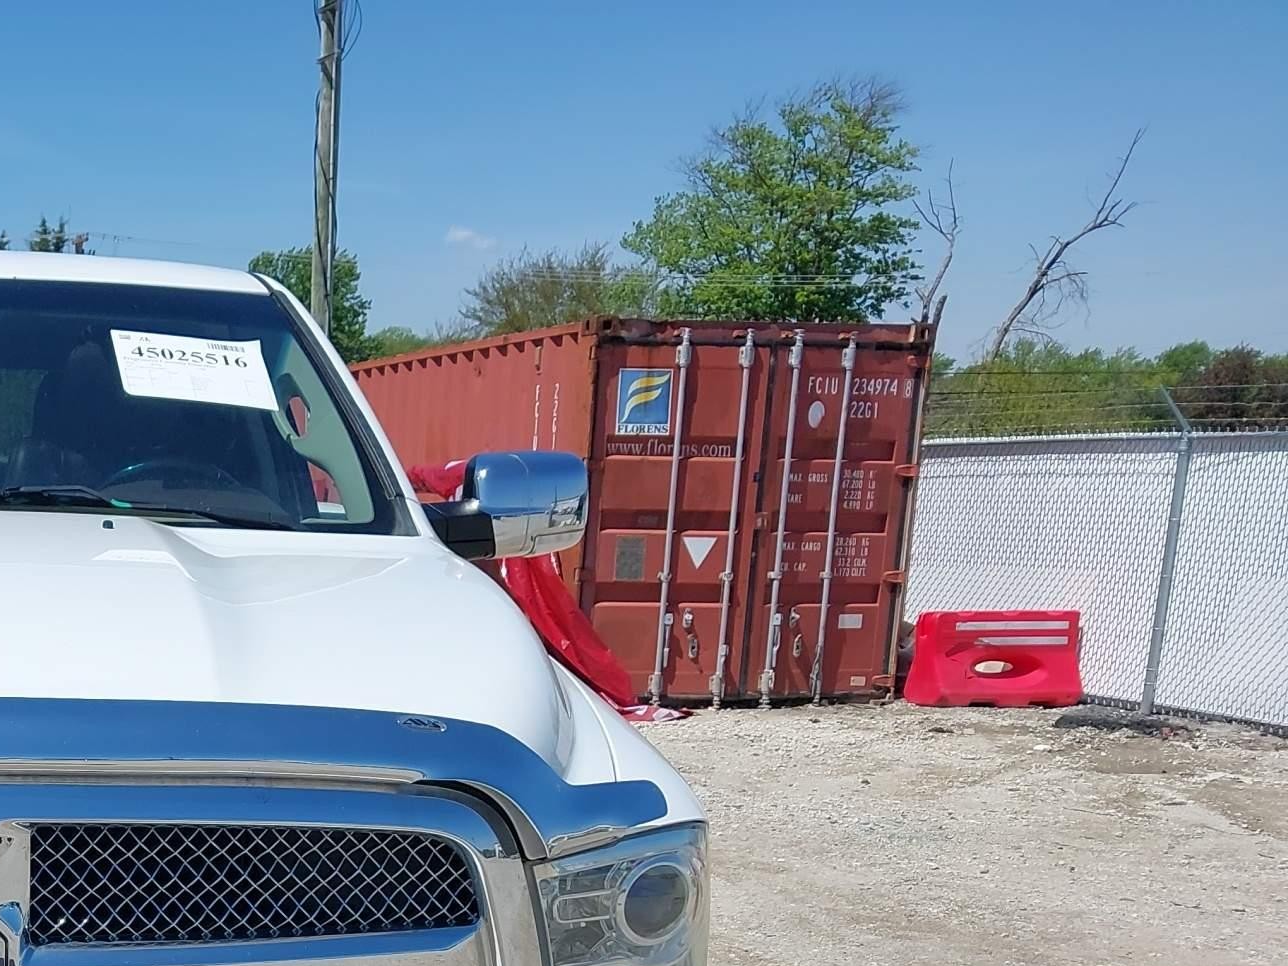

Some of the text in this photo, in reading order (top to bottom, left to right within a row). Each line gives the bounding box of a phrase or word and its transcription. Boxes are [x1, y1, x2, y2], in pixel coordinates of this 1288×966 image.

[130, 345, 248, 368] 45025516
[808, 376, 913, 398] FCIU 234974 8
[850, 401, 878, 419] 22G1
[617, 424, 669, 434] FLORENS
[607, 439, 731, 457] www.florns.com
[808, 473, 828, 483] GROSS
[801, 542, 821, 551] CARGO
